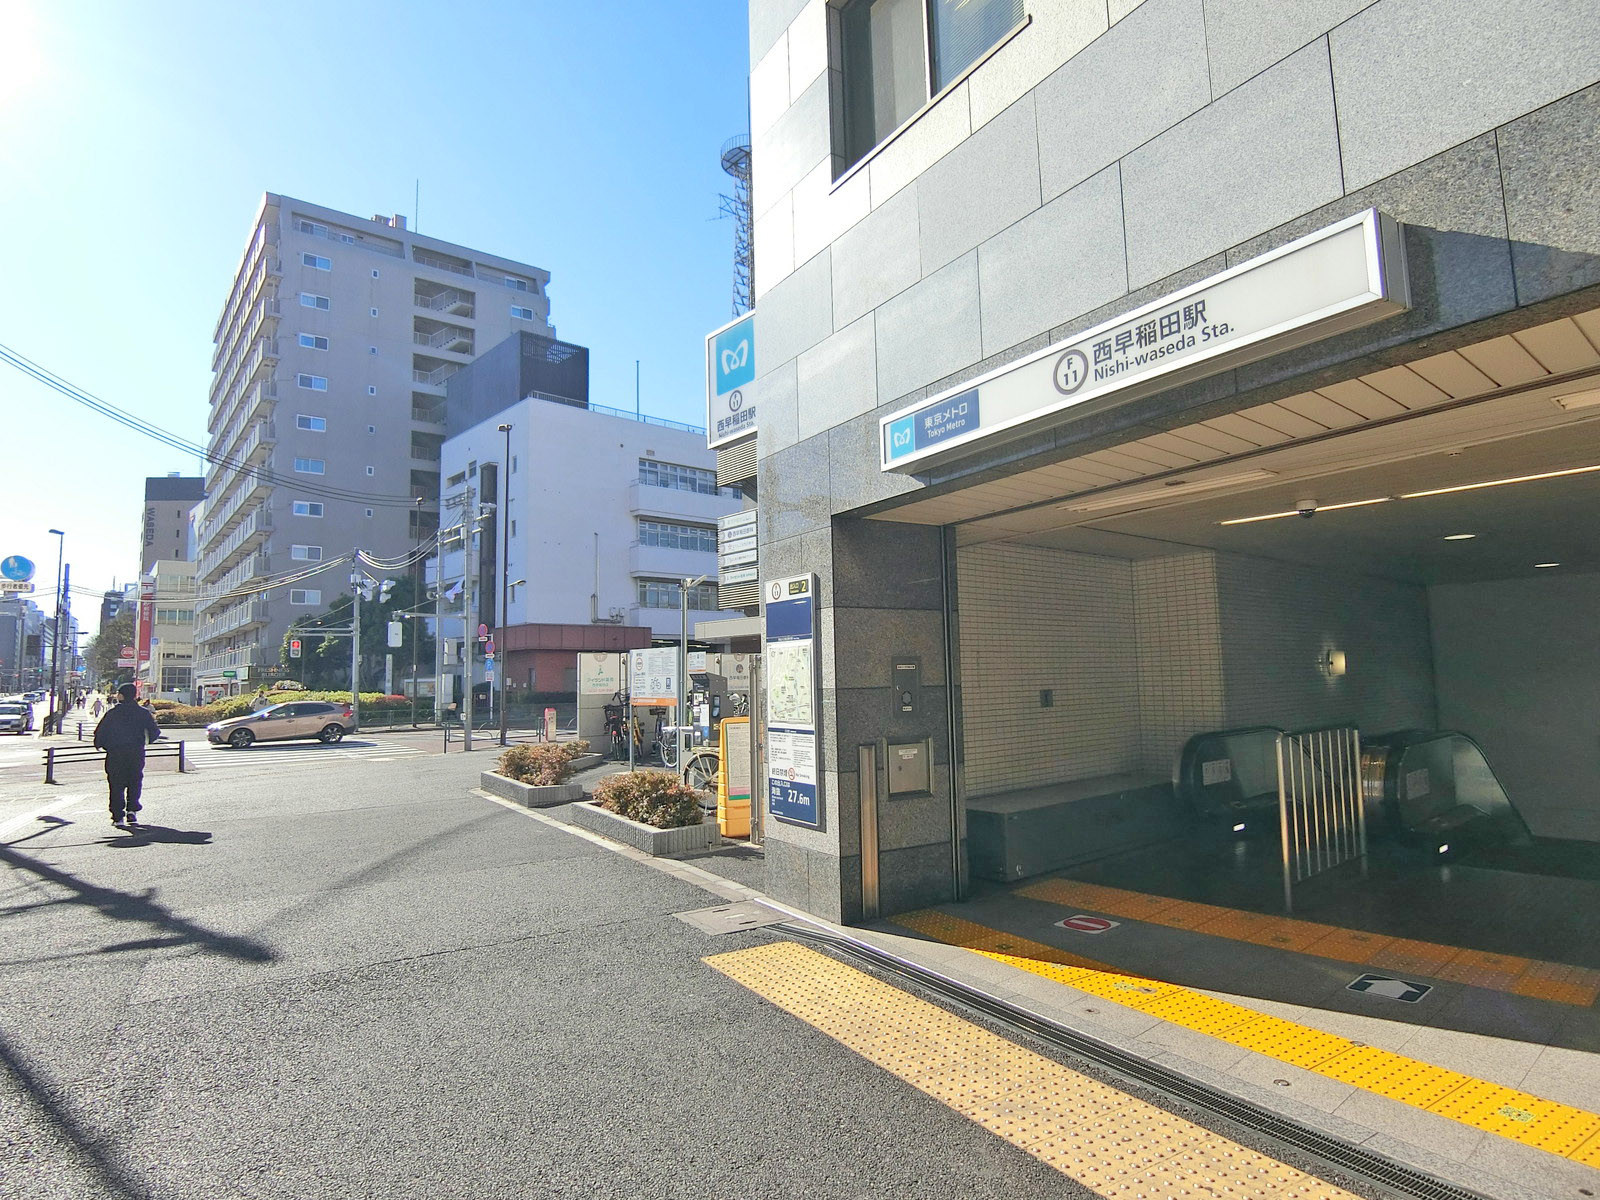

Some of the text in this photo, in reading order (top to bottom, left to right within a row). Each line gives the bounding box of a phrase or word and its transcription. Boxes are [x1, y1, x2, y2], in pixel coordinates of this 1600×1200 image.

[1093, 300, 1207, 366] 西早稲田駅
[1094, 323, 1235, 381] Nishi-waseda Sta.
[1067, 358, 1073, 370] F
[1064, 370, 1078, 385] 11
[717, 406, 756, 432] 西早稲田駅
[924, 402, 968, 430] 東京メトロ
[927, 419, 966, 439] Tokyo Metro
[145, 507, 155, 547] WASEDA
[801, 581, 807, 592] 2
[787, 789, 810, 806] 27.6m
